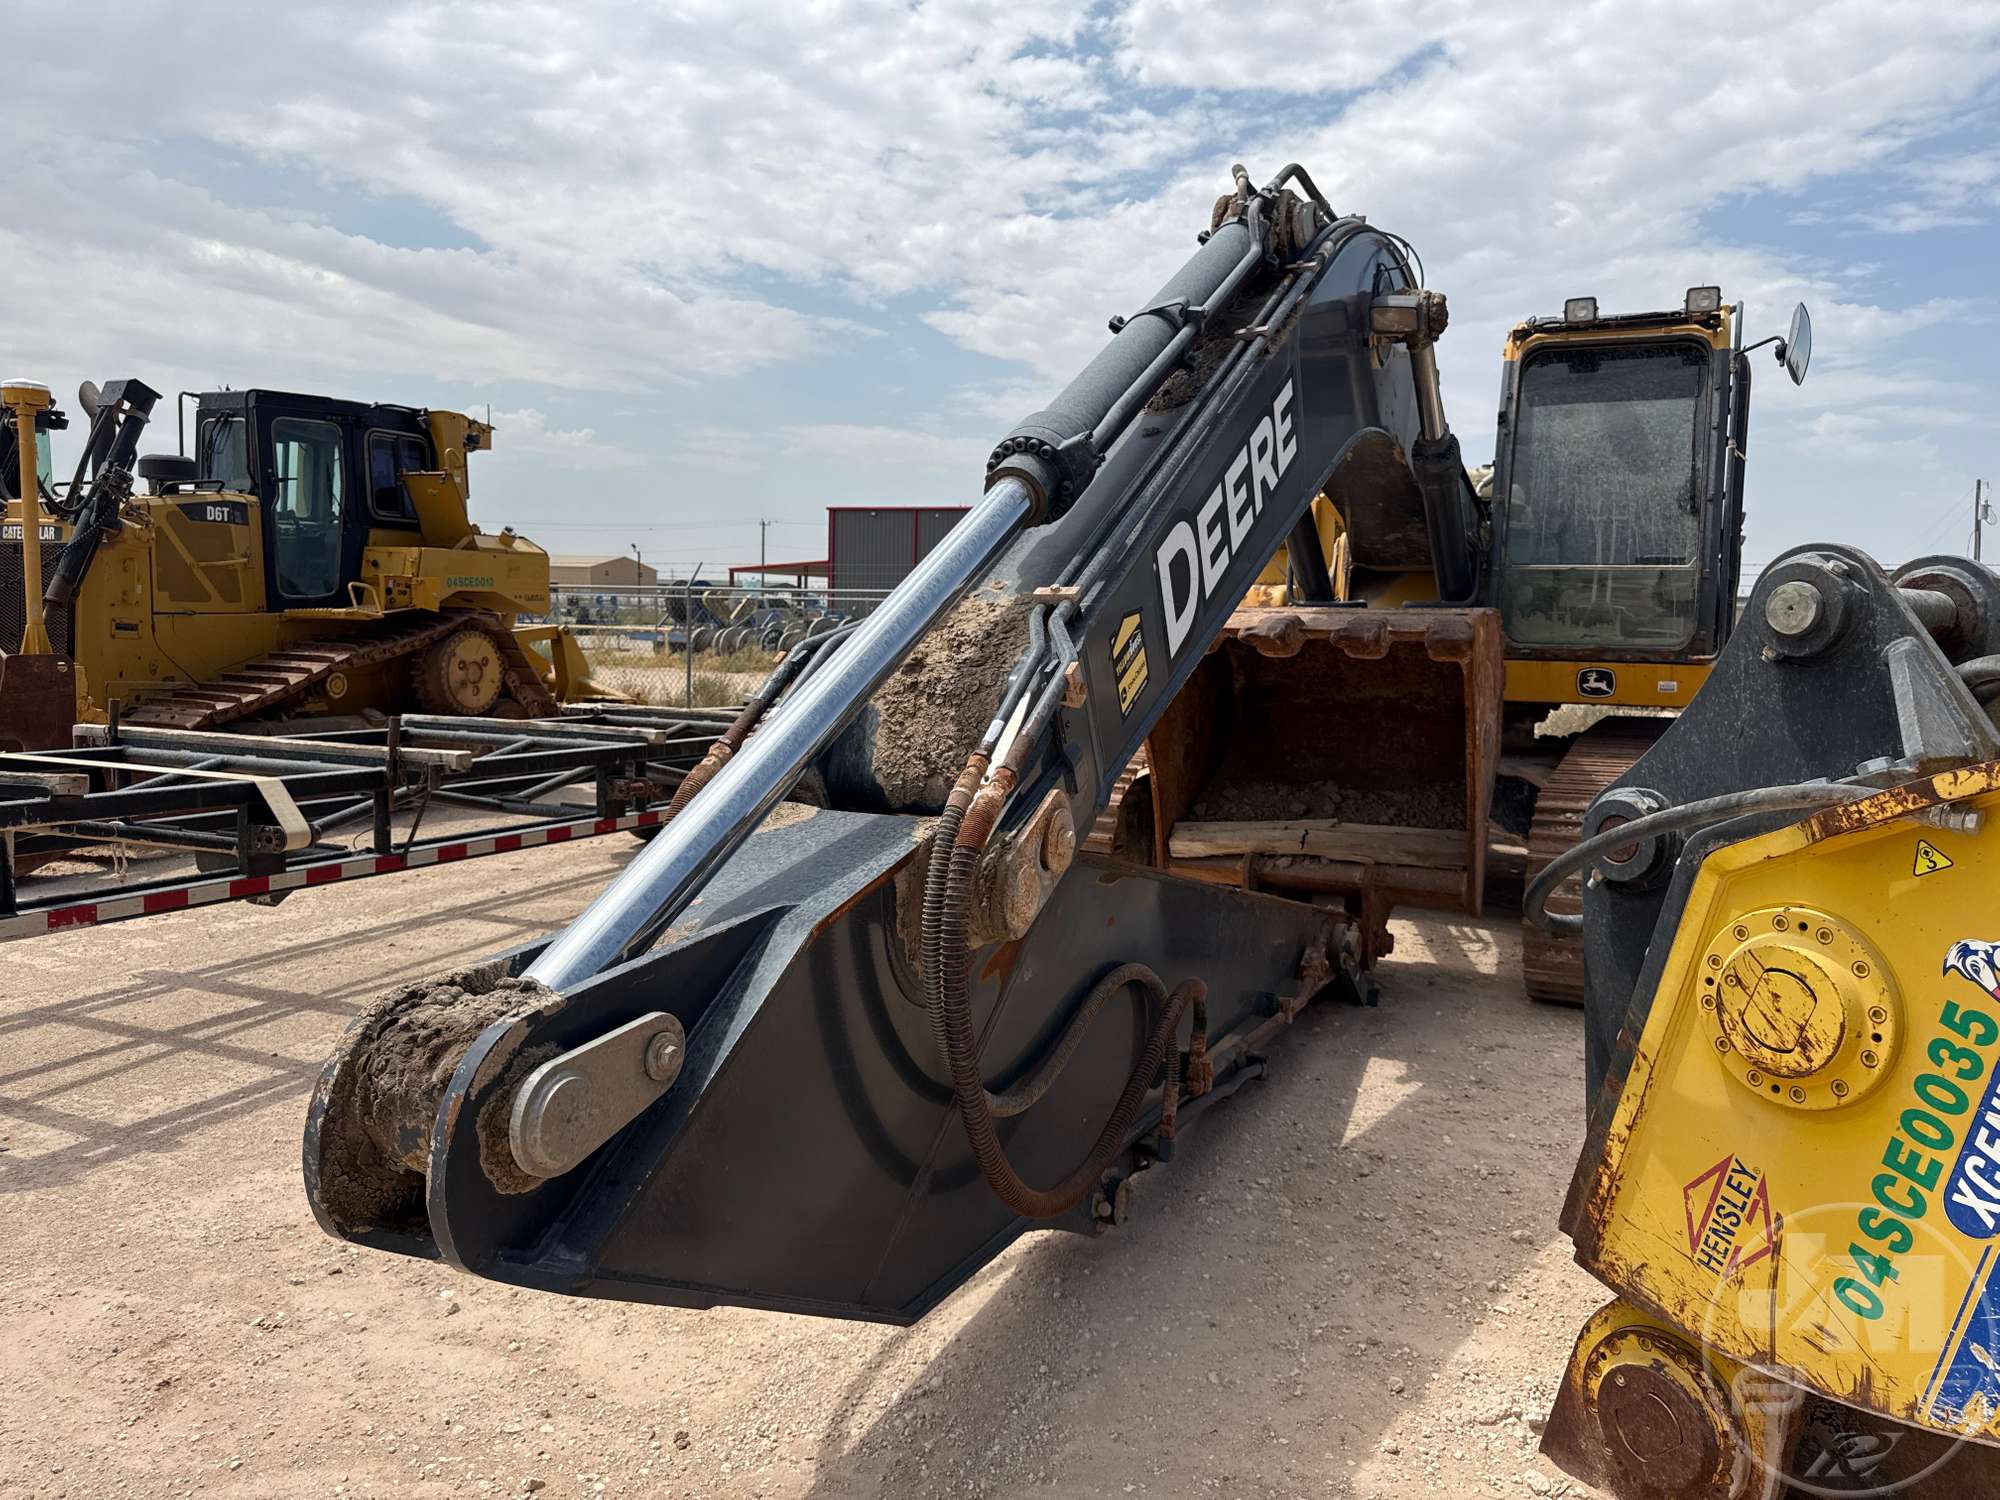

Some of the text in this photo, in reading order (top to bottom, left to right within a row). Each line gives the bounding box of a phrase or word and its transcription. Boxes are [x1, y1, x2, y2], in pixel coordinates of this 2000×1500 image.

[2, 526, 55, 540] CATELAR
[206, 505, 230, 522] D6T
[1157, 377, 1298, 660] DEERE
[1696, 1157, 1758, 1276] HENSLEY
[1833, 999, 1999, 1321] 04SCE0035
